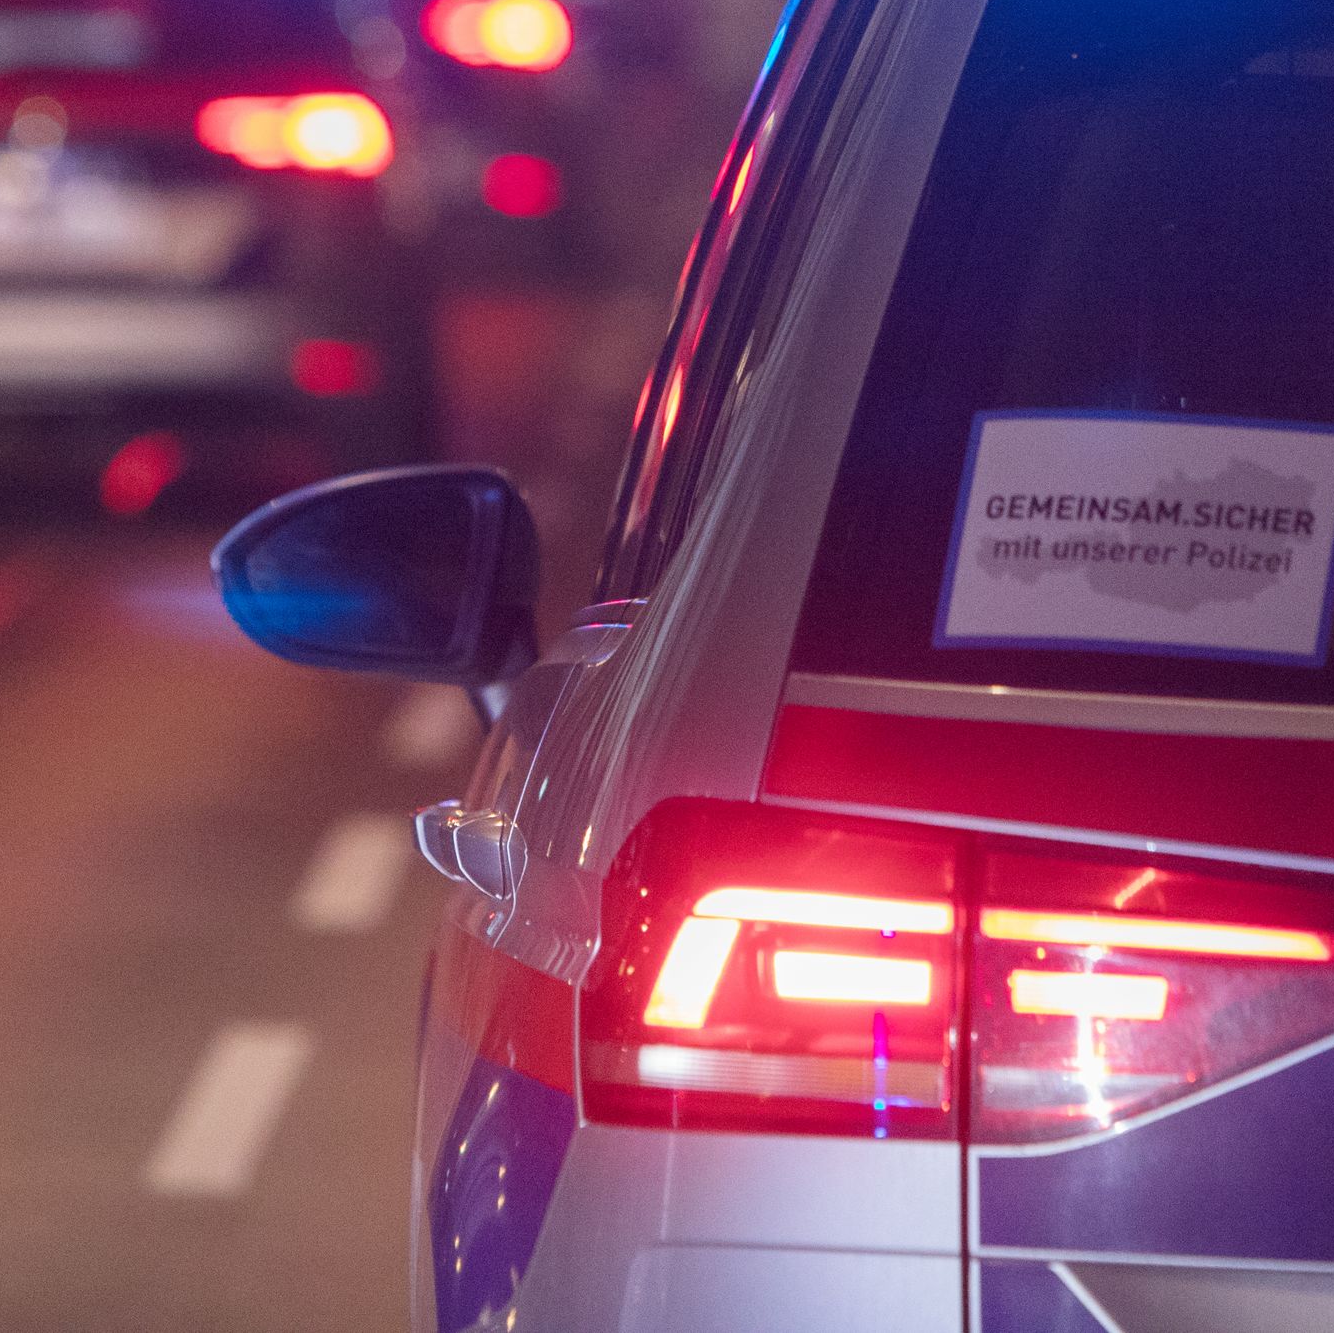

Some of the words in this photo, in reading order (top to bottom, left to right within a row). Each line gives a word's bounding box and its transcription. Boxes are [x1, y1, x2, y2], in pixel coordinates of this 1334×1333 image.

[985, 494, 1316, 535] GEMEINSAM.SICHER
[992, 535, 1043, 561] mit
[1051, 538, 1178, 565] unserer
[1186, 539, 1293, 575] Polizei
